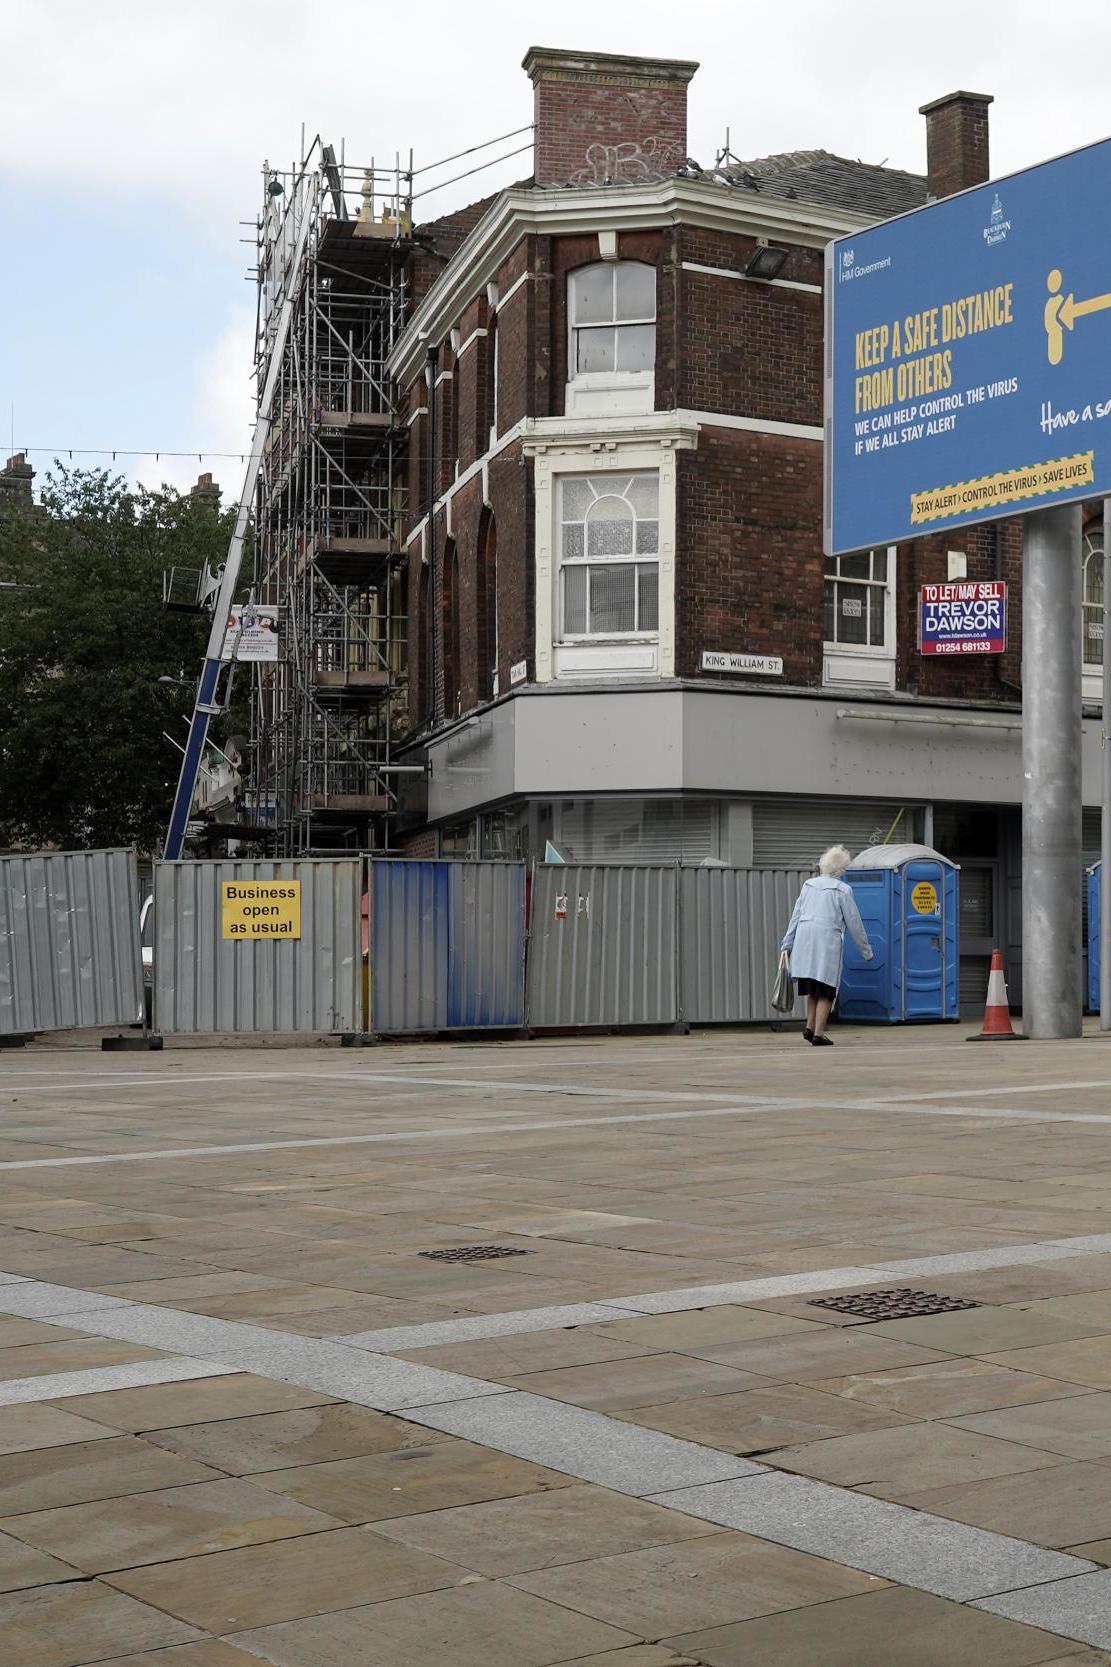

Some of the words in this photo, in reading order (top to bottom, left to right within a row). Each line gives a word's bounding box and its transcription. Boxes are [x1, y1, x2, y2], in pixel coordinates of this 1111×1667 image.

[842, 271, 854, 282] HM
[854, 256, 891, 279] Government
[855, 324, 889, 370] KEEP
[892, 321, 901, 358] A
[904, 308, 938, 355] SAFE
[942, 283, 1014, 343] DISTANCE
[855, 367, 894, 415] FROM
[897, 349, 952, 402] OTHERS
[855, 421, 869, 436] WE
[872, 414, 891, 432] CAN
[894, 406, 917, 426] HELP
[919, 393, 964, 418] CONTROL
[966, 386, 985, 408] THE
[987, 376, 1018, 399] VIRUS
[1040, 400, 1079, 435] Have
[1082, 405, 1093, 420] a
[855, 441, 864, 456] IF
[865, 436, 880, 452] WE
[882, 431, 899, 448] ALL
[901, 424, 924, 443] STAY
[926, 415, 956, 437] ALERT
[916, 499, 933, 514] STAY
[934, 494, 956, 510] ALERT
[962, 484, 998, 503] CONTROL
[999, 480, 1013, 494] THE
[1014, 473, 1038, 491] VIRUS
[1043, 468, 1064, 484] SAVE
[1065, 462, 1087, 479] LIVES
[925, 586, 938, 600] TO
[939, 584, 977, 601] LET/MAY
[978, 583, 1001, 599] SELL
[926, 600, 1000, 617] TREVOR
[926, 614, 1000, 632] DAWSON
[936, 643, 961, 653] 01254
[962, 641, 991, 652] 681133
[705, 655, 725, 666] KING
[729, 657, 764, 669] WILLIAM
[226, 886, 296, 899] Business
[242, 906, 280, 919] open
[230, 923, 247, 933] as
[251, 920, 293, 933] usual
